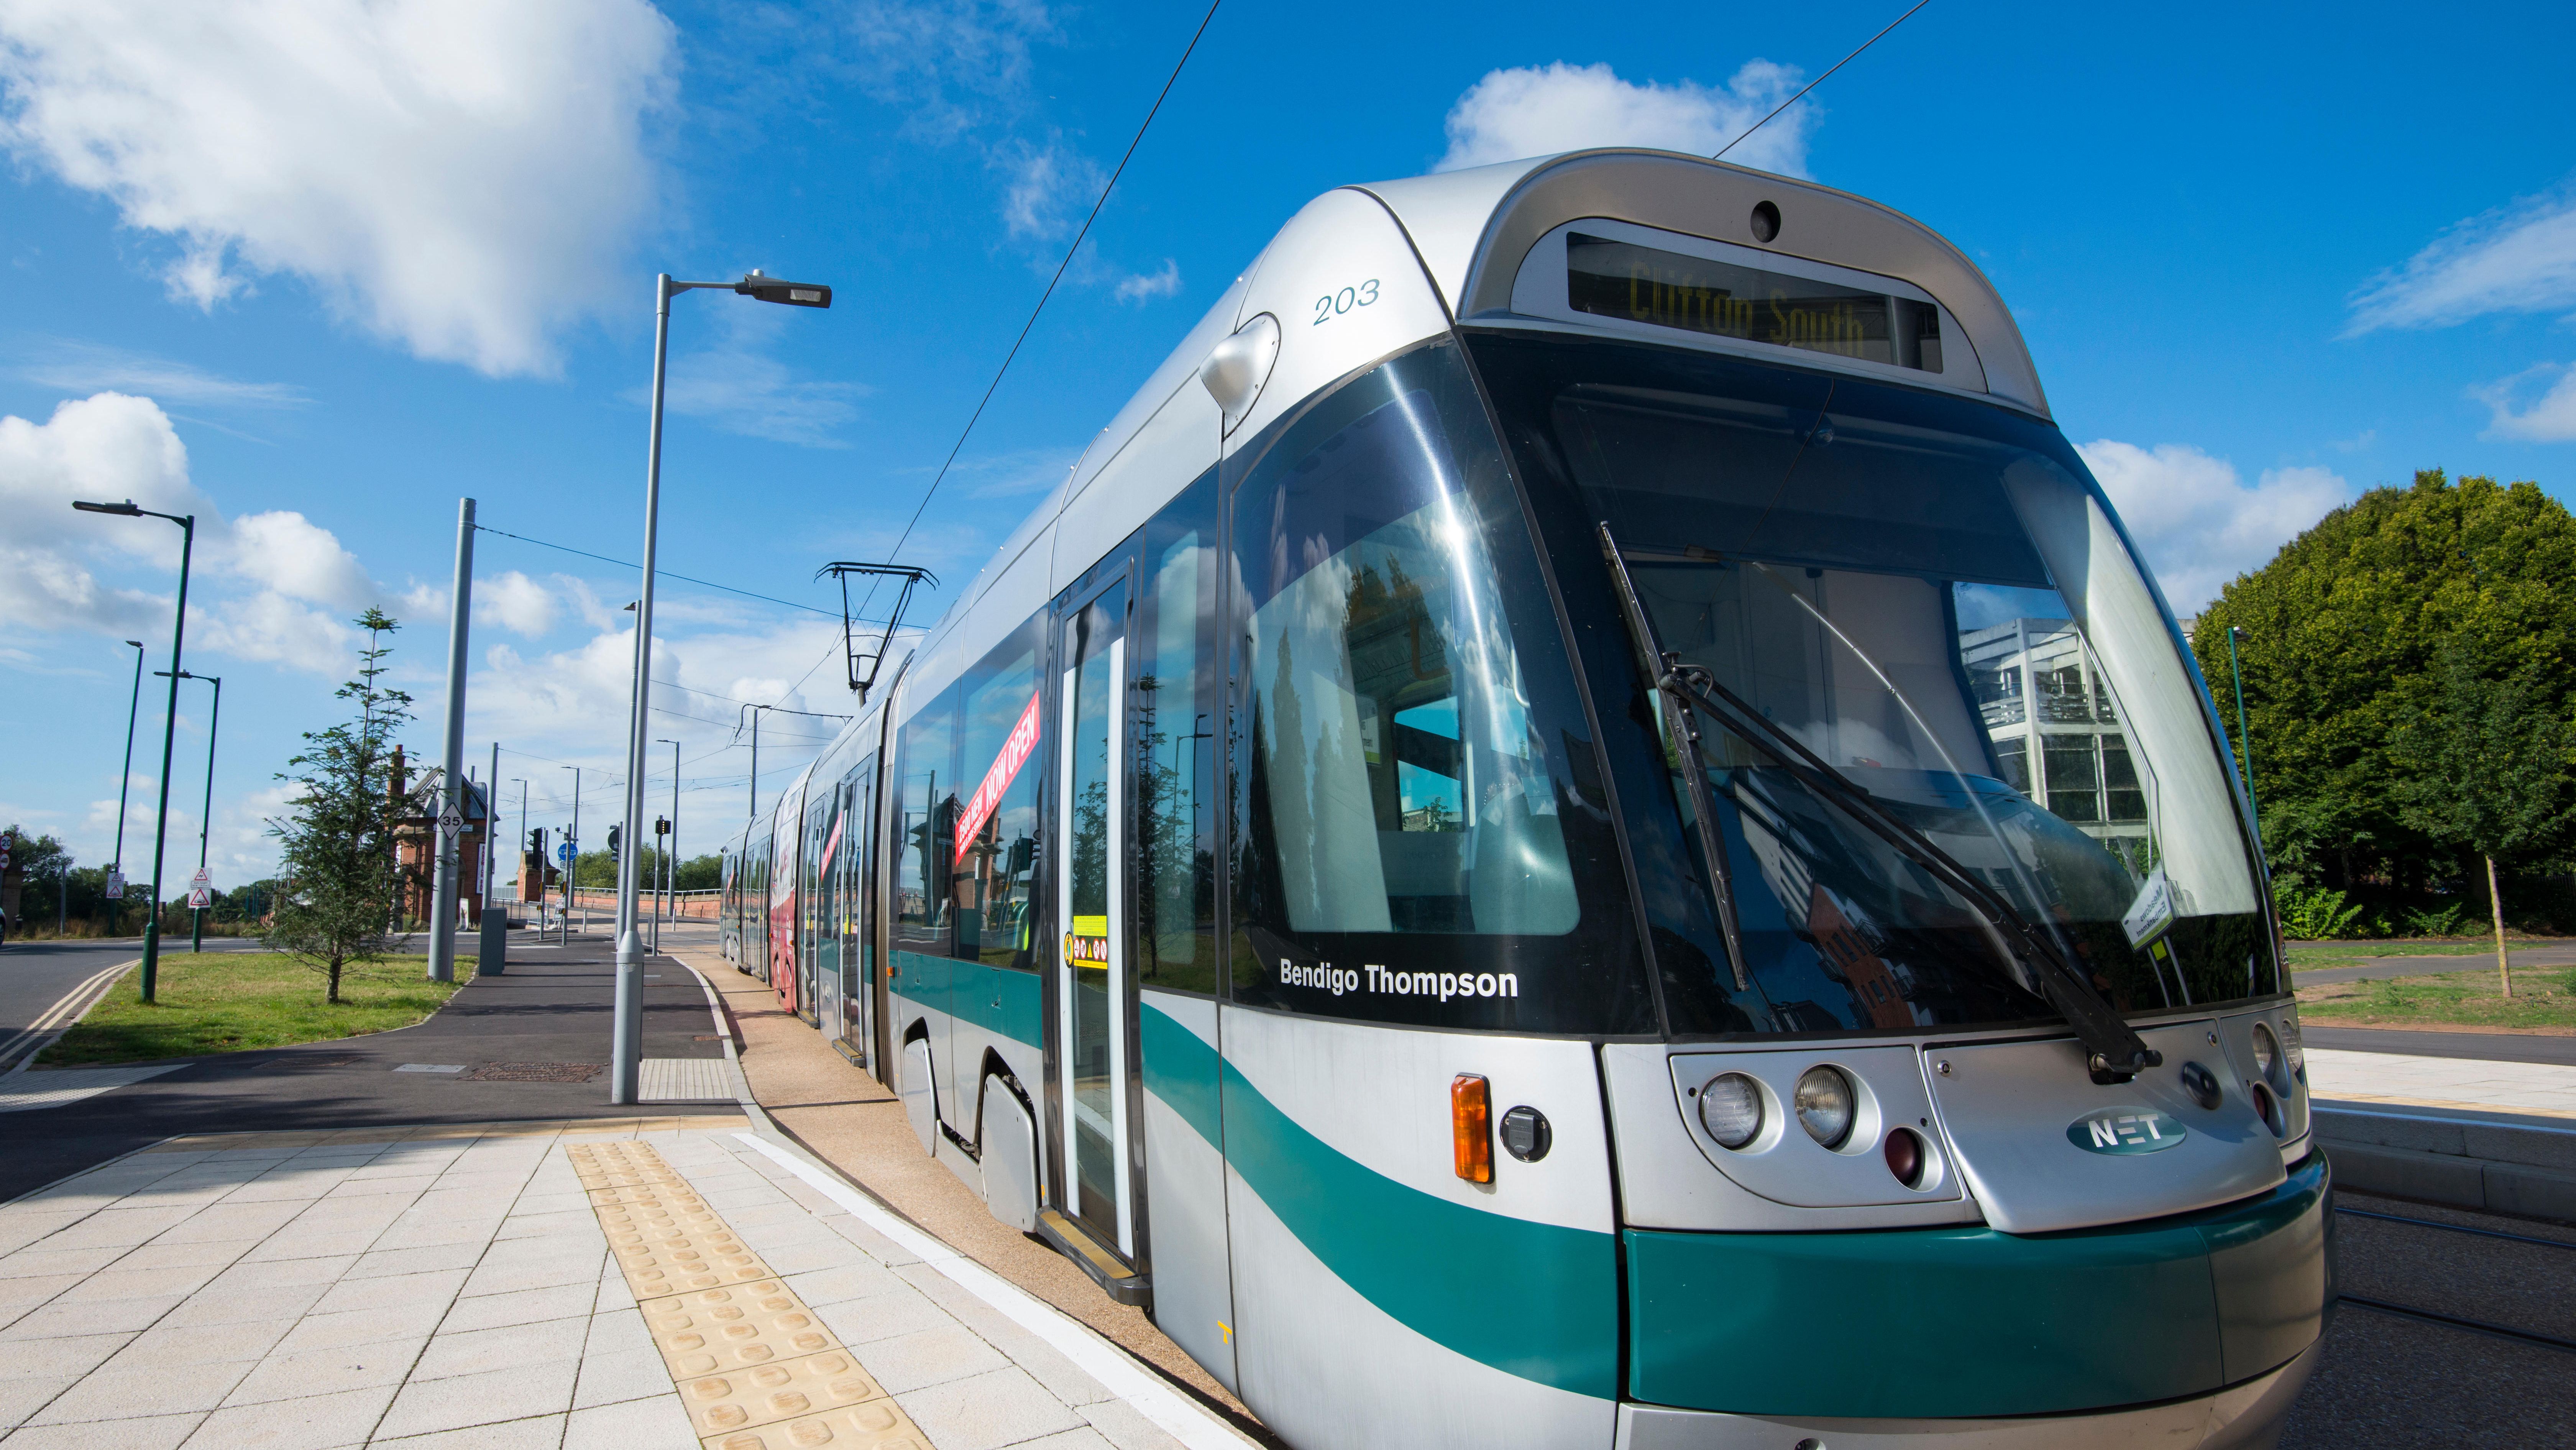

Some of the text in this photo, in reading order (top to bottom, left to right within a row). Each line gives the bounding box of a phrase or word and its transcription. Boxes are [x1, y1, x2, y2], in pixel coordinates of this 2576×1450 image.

[1313, 279, 1380, 326] 203
[1630, 261, 1863, 358] Clifton South
[986, 705, 1035, 812] NOW OPEN
[443, 816, 460, 826] 35
[959, 790, 983, 844] 2500 NEW
[974, 812, 983, 834] SPACES
[1281, 958, 1518, 1002] Bendigo Thompson
[2088, 1113, 2161, 1148] NET
